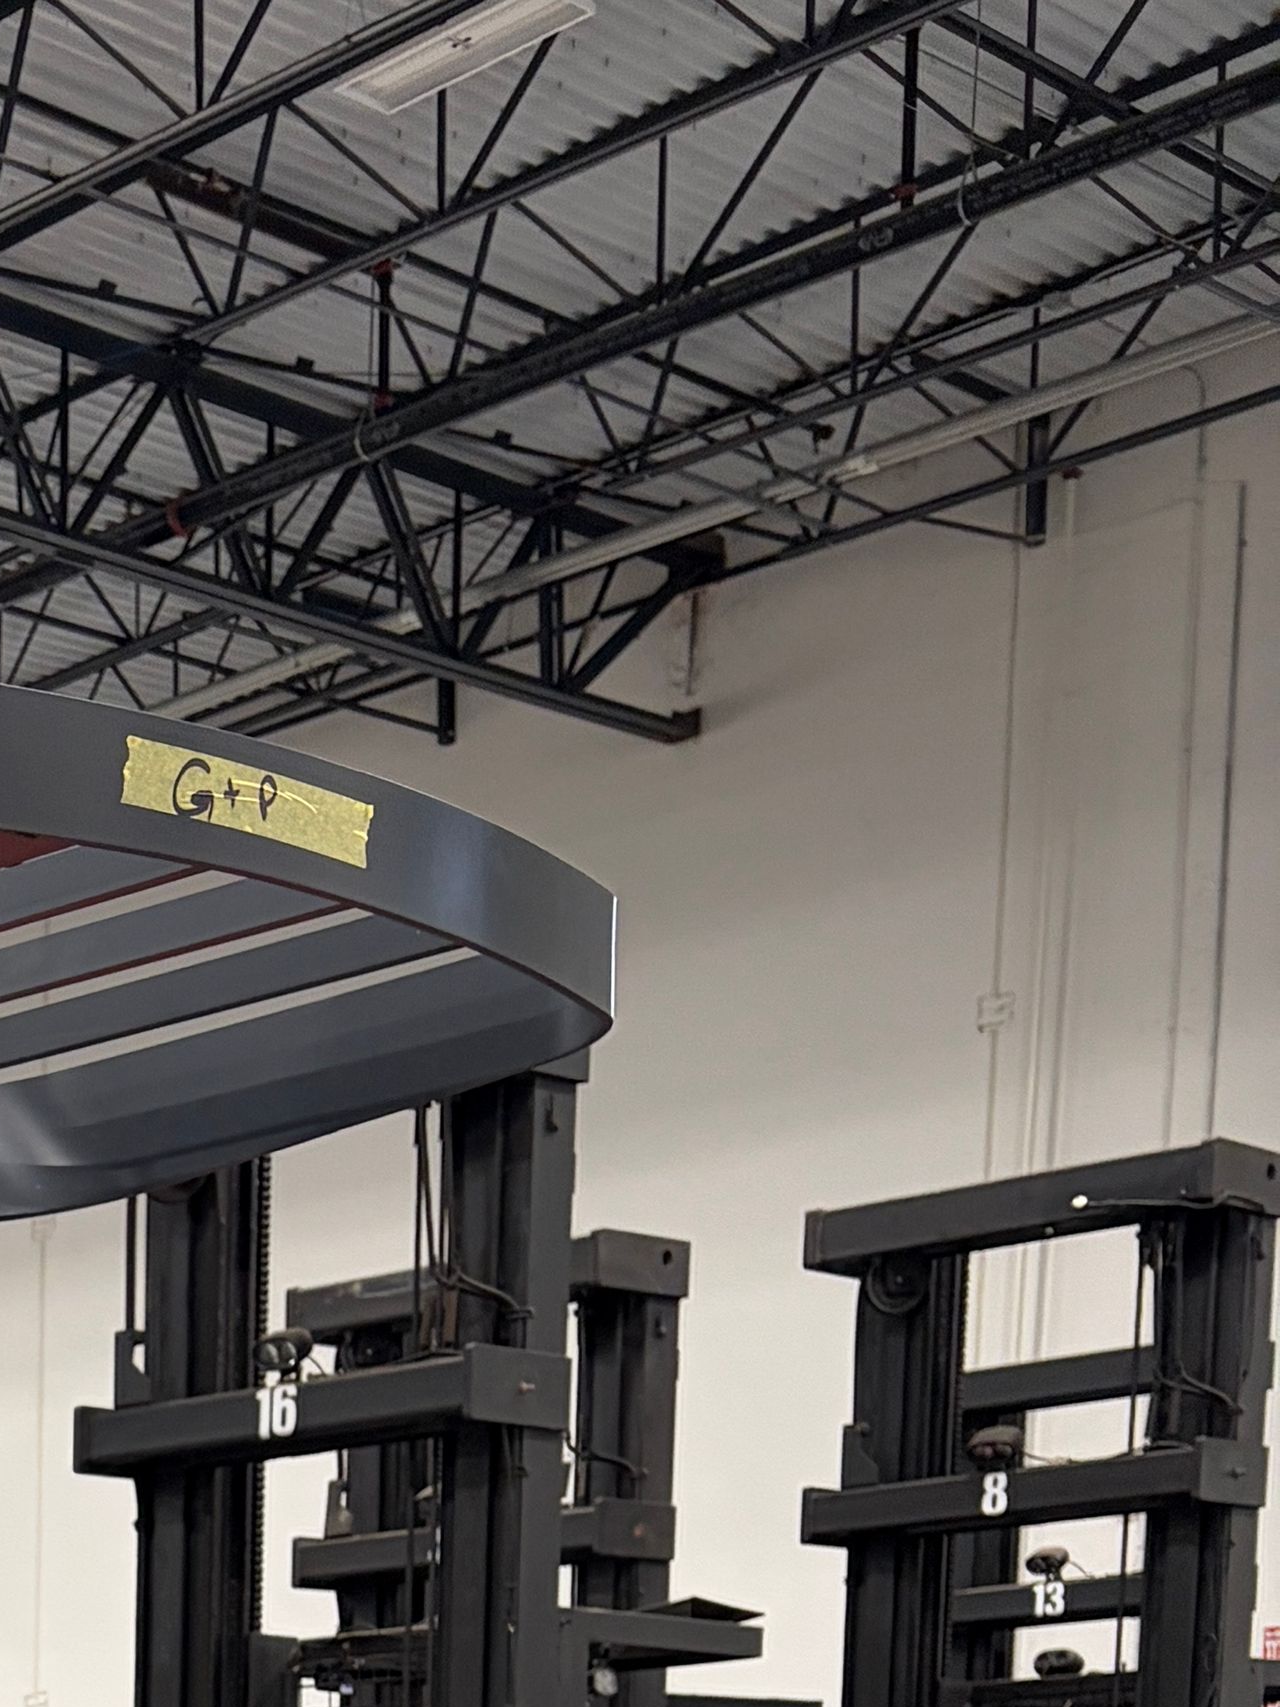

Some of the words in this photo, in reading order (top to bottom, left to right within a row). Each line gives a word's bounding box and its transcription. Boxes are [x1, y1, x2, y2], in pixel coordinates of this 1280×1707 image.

[255, 1384, 298, 1440] 16
[981, 1471, 1008, 1516] 8
[1032, 1581, 1065, 1617] 13
